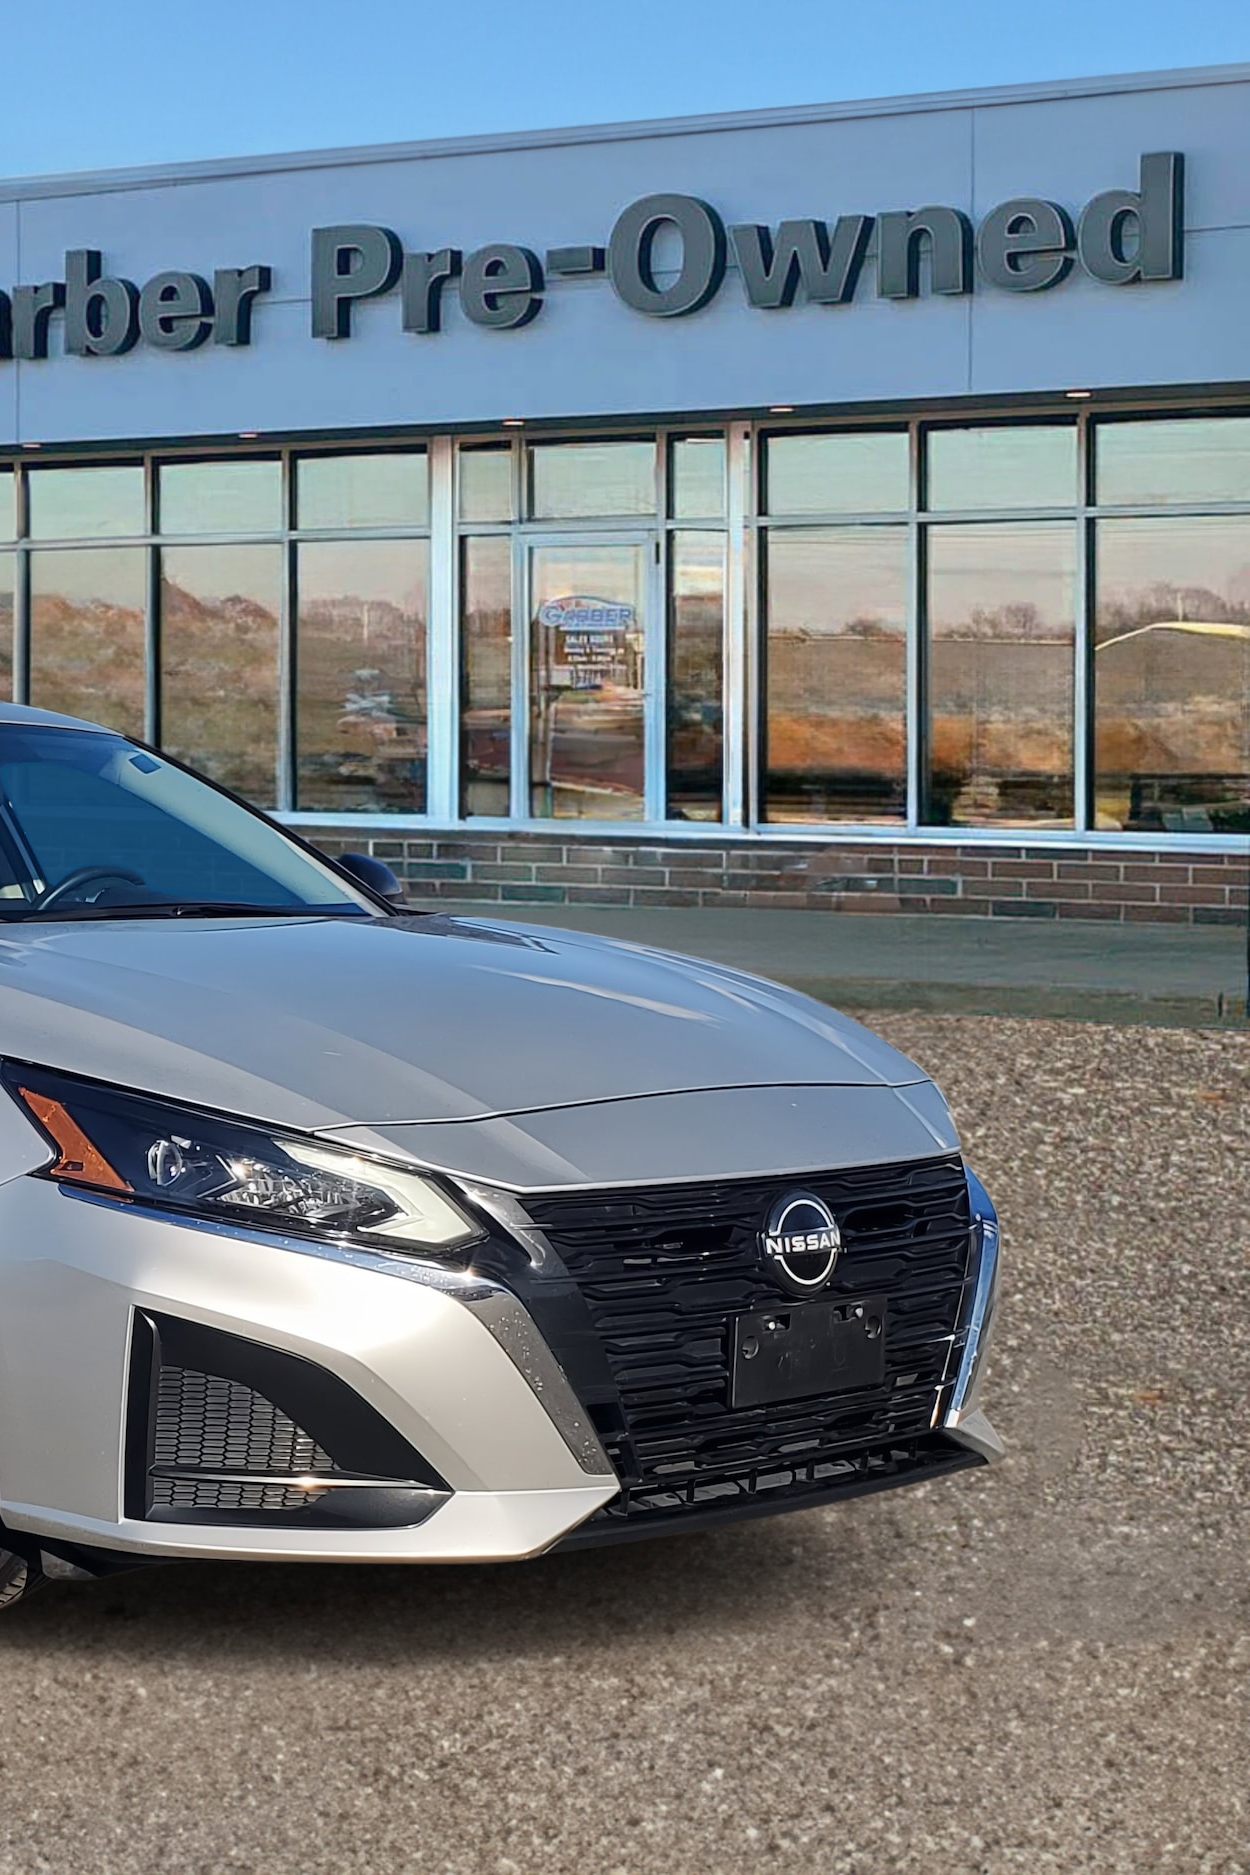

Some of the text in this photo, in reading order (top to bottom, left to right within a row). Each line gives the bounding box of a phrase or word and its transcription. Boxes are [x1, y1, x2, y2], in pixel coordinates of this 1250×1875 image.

[311, 151, 1185, 338] Pre-Owned
[543, 604, 632, 624] GARBER
[766, 1231, 841, 1254] NISSAN
